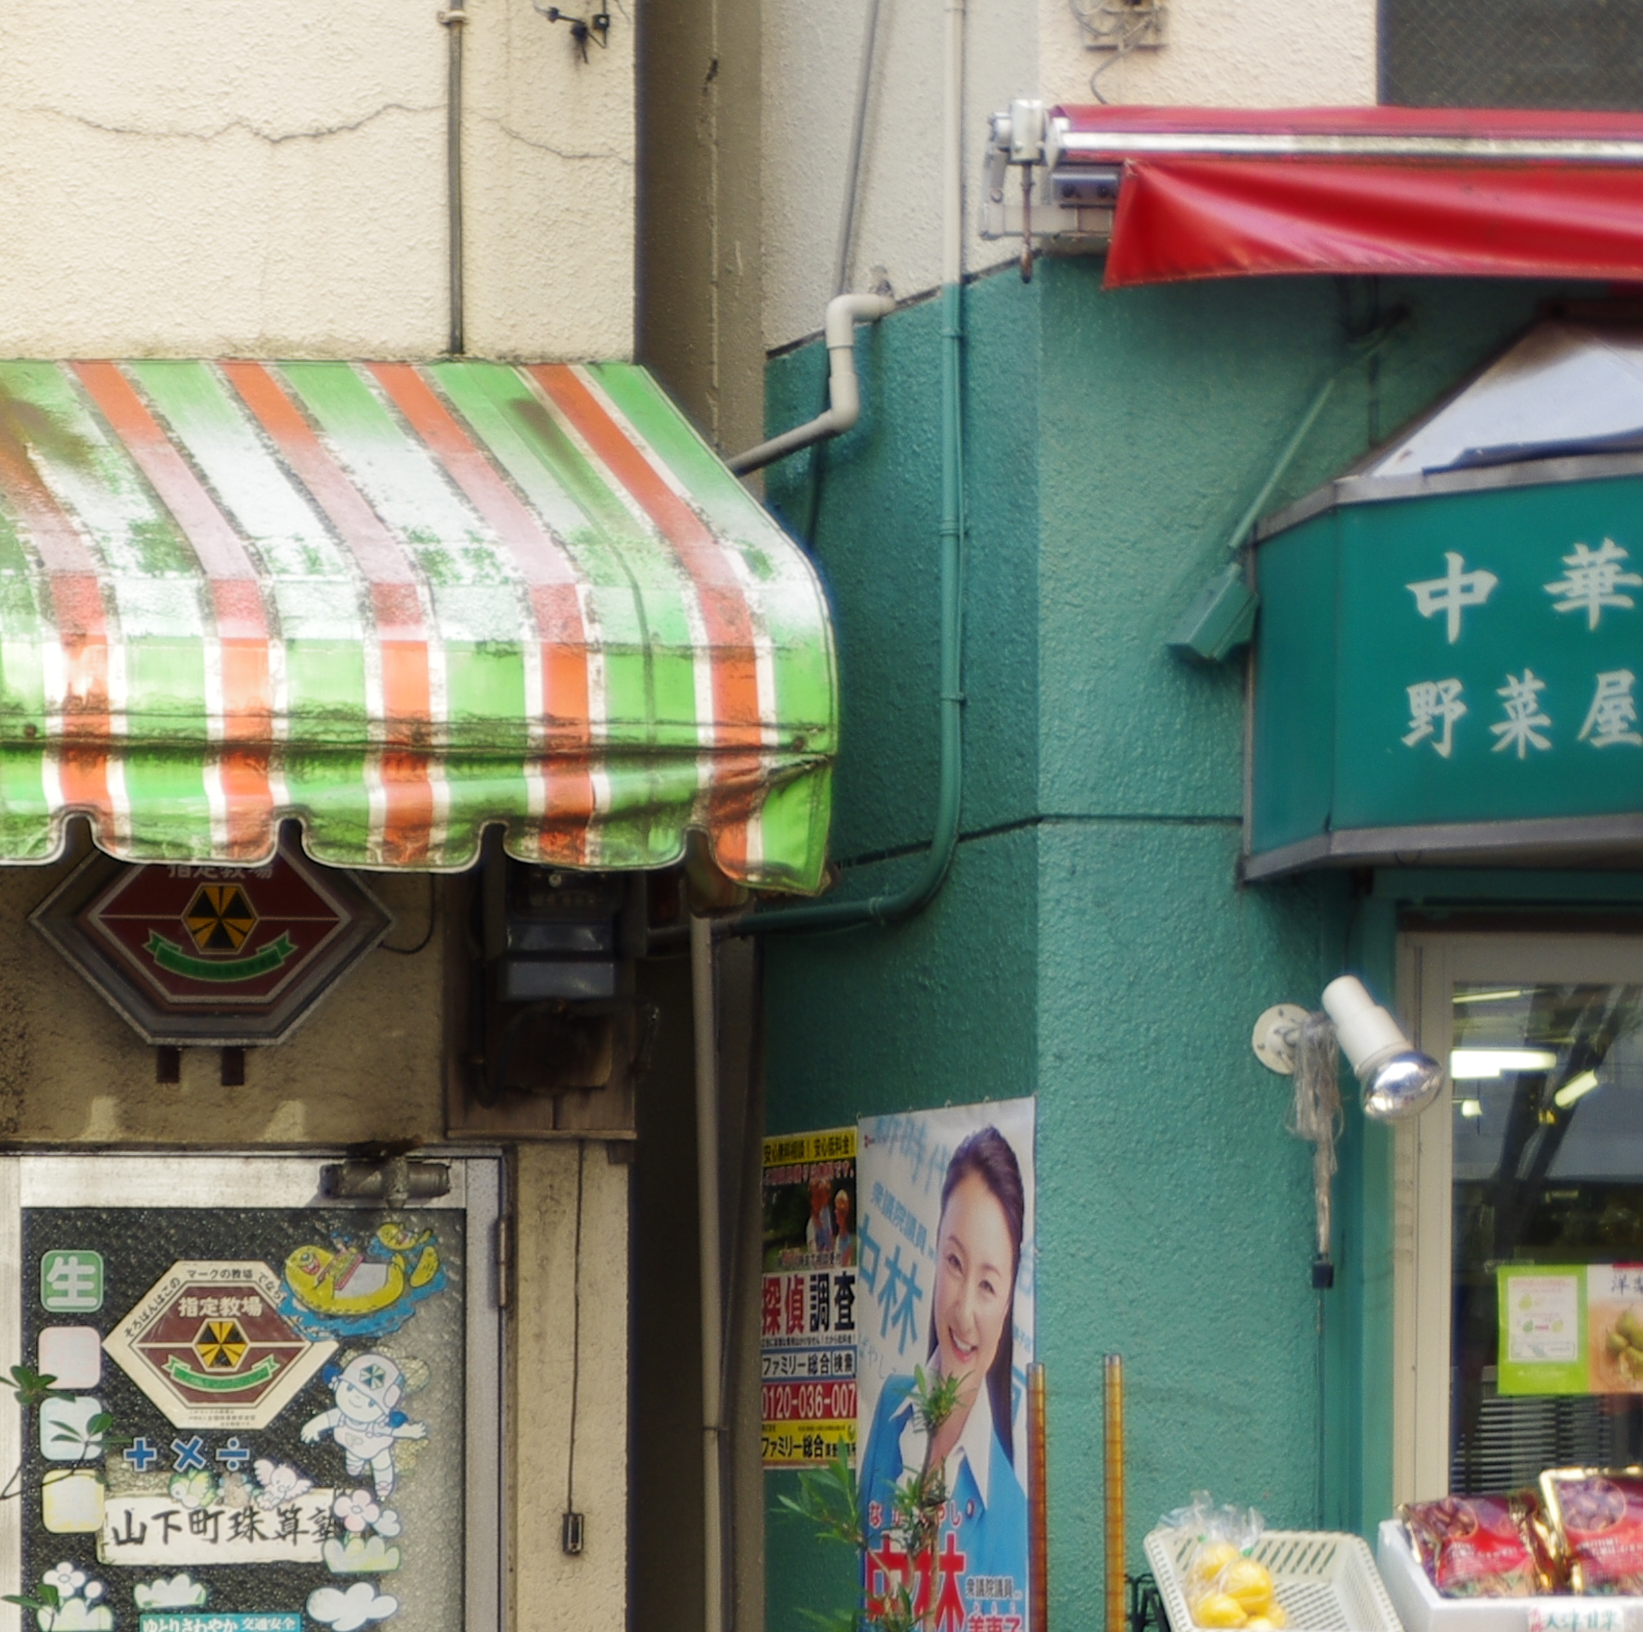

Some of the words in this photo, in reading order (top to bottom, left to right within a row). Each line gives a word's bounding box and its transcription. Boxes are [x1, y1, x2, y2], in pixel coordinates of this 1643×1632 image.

[1405, 537, 1643, 644] 中華
[1400, 667, 1643, 760] 野菜屋
[45, 1256, 98, 1308] 生
[178, 1296, 263, 1318] 指定教場
[761, 1271, 856, 1336] 探偵調査
[763, 1354, 829, 1376] ファミリー総合
[761, 1382, 856, 1419] 0120-036-007
